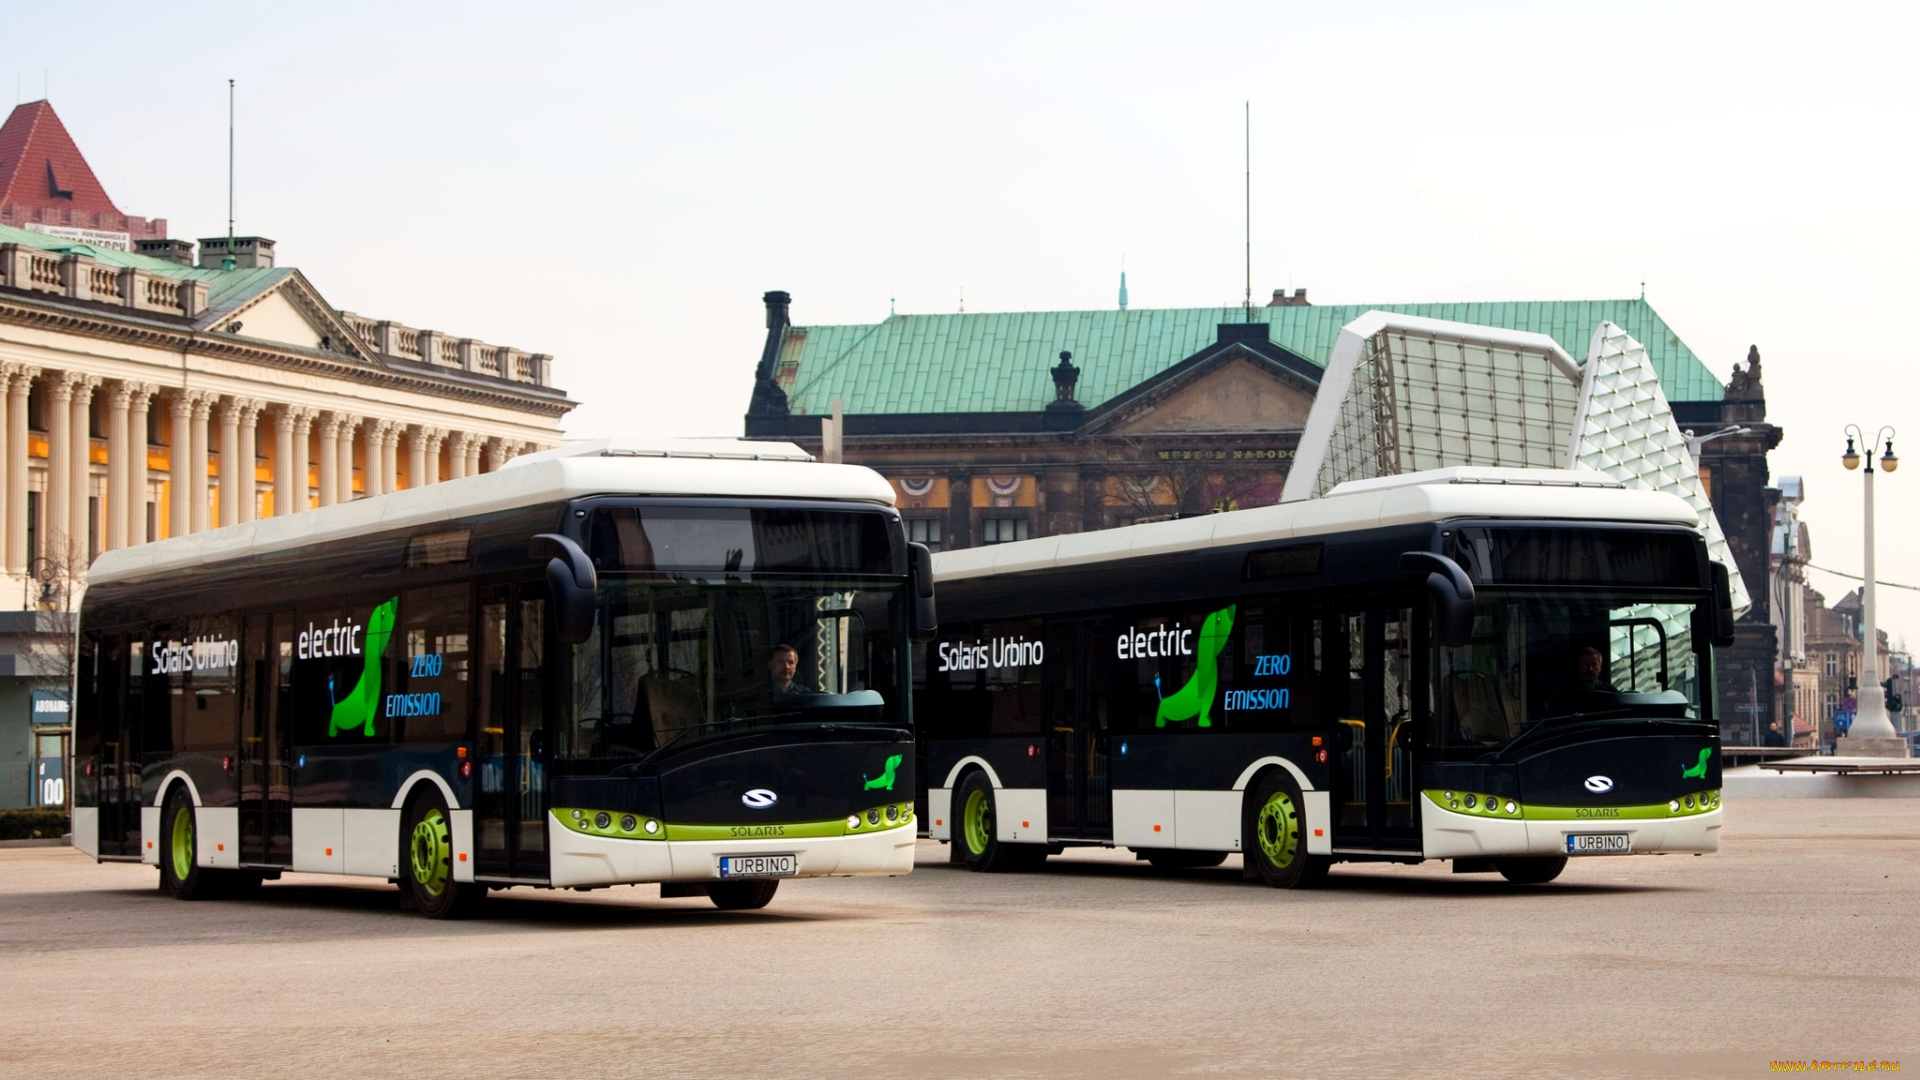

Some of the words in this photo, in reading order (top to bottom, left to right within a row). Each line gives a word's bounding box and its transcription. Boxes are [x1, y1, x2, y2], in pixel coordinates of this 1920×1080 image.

[1158, 450, 1226, 459] MUZEUM
[299, 617, 361, 660] electric
[1117, 622, 1192, 660] electric
[152, 638, 193, 675] Solaris
[196, 633, 239, 671] Urbino
[938, 641, 989, 672] Solaris
[992, 635, 1044, 668] Urbino
[411, 653, 442, 678] ZERO
[1254, 654, 1291, 676] ZERO
[1575, 808, 1619, 818] SOLARIS
[730, 825, 785, 837] SOLARIS
[1579, 836, 1624, 849] URBINO
[734, 857, 789, 873] URBINO
